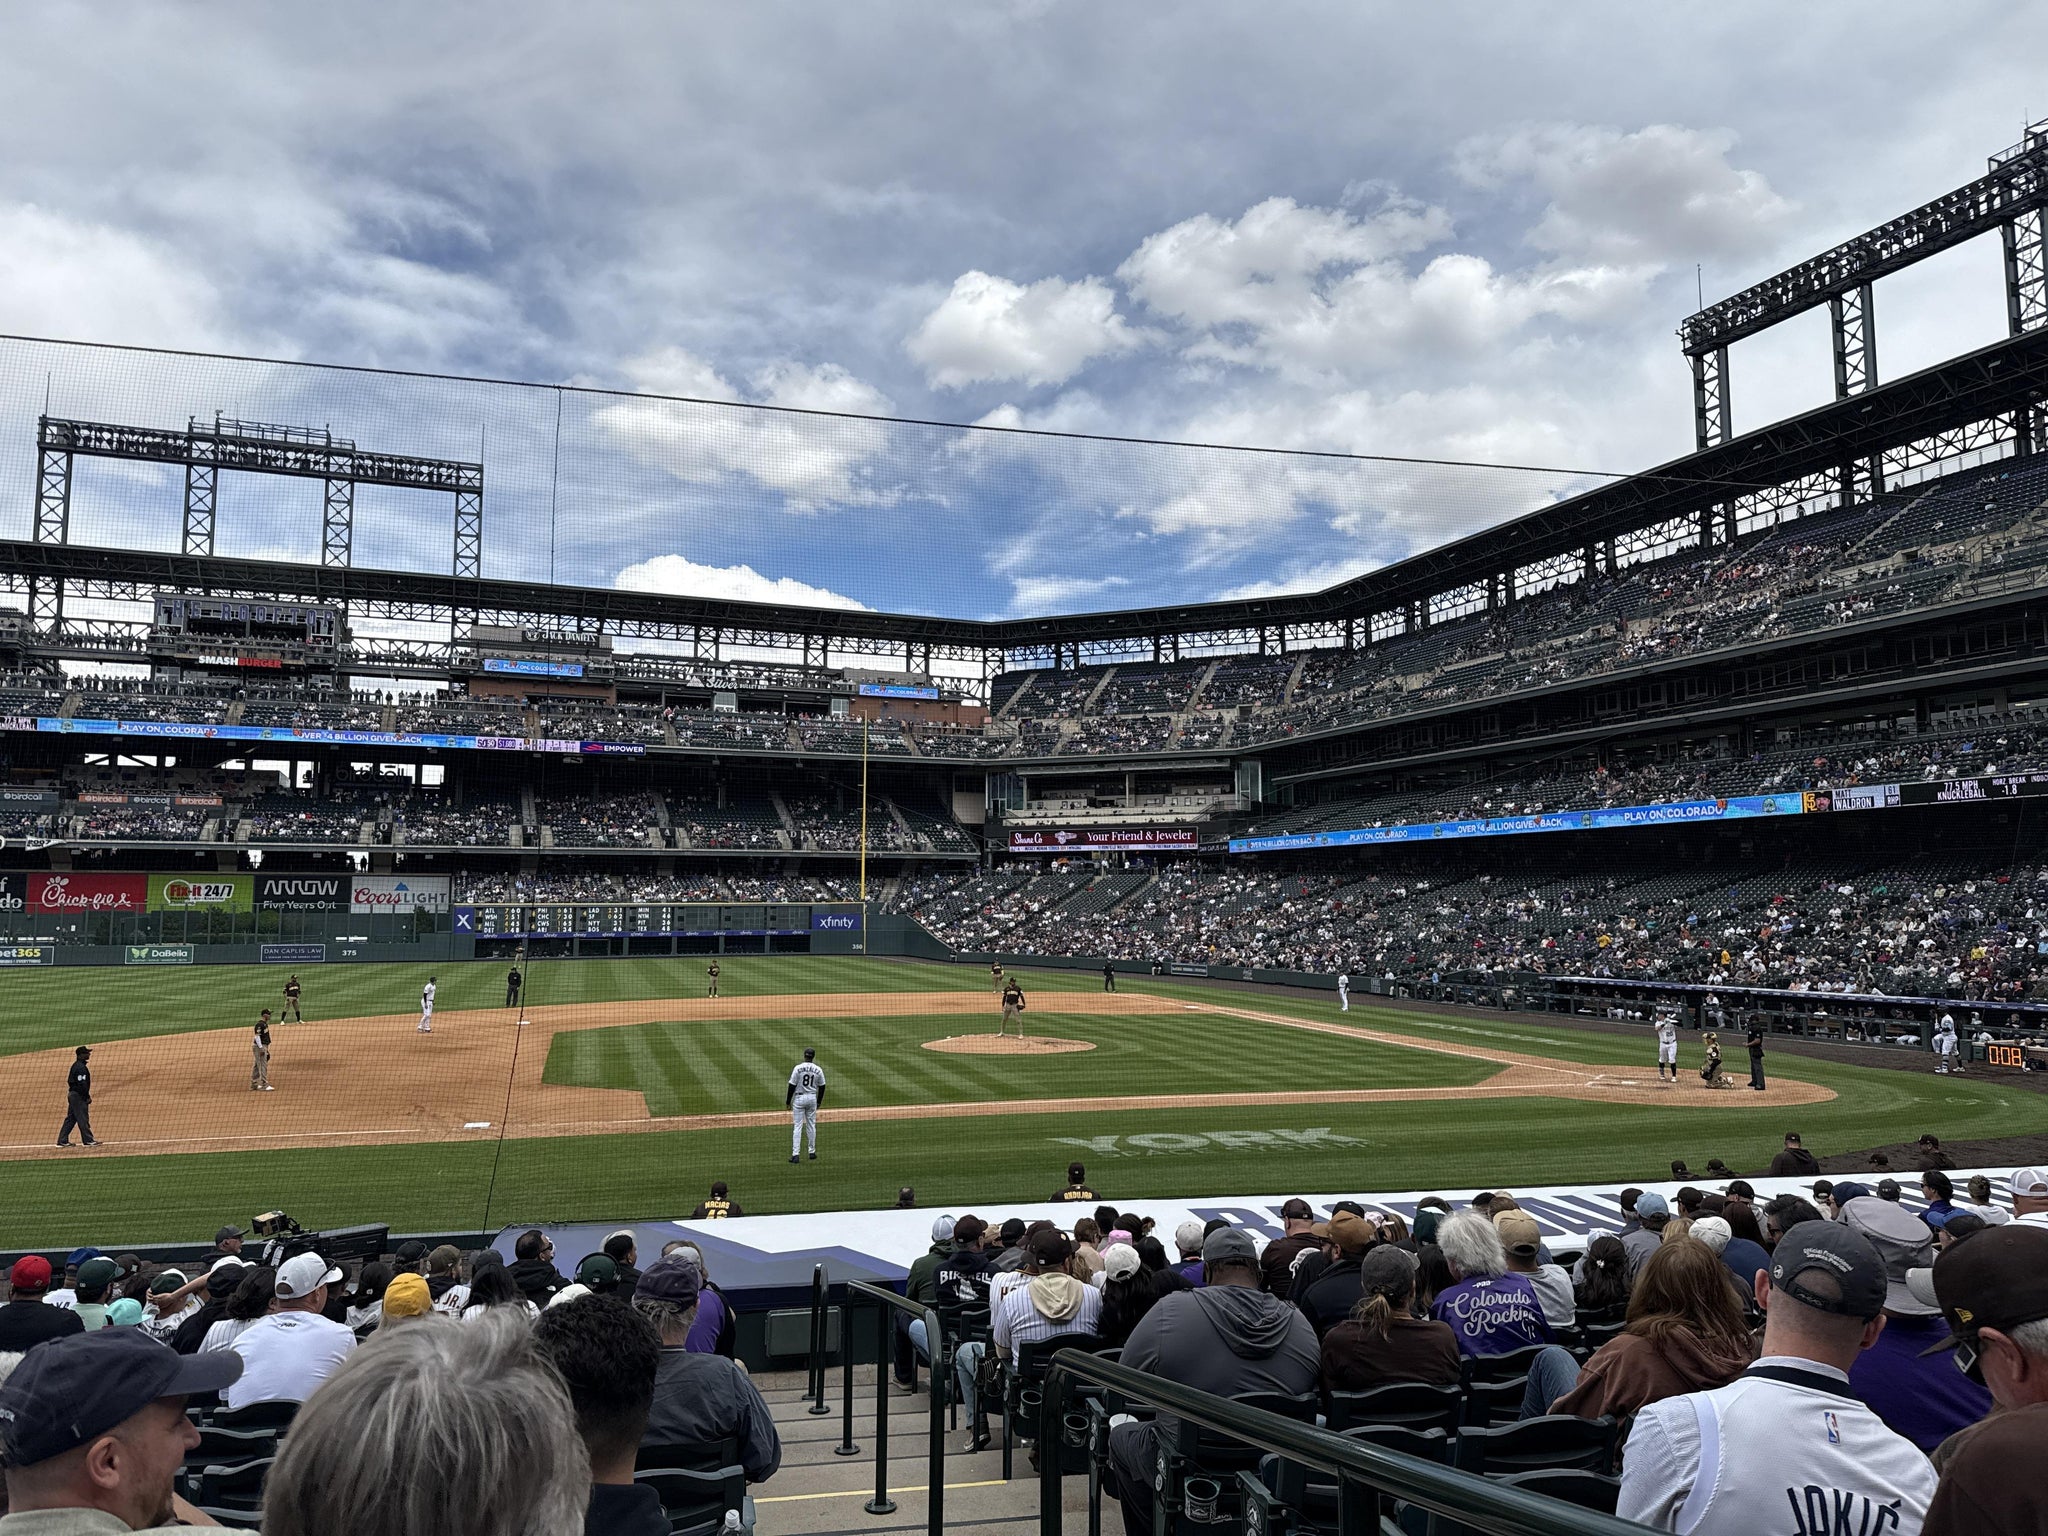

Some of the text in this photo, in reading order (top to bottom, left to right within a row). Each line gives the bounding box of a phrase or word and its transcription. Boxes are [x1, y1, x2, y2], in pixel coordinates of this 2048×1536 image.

[154, 600, 335, 627] THE ROOFTOP
[198, 655, 282, 668] SMASHBURGER
[706, 678, 738, 690] Silver
[120, 724, 144, 732] PLAY
[147, 726, 163, 734] ON,
[299, 731, 321, 740] OVER
[334, 732, 369, 742] BILLION
[370, 734, 397, 743] GIVEN
[1962, 780, 1978, 790] MPH
[2008, 776, 2026, 784] BREAK
[92, 795, 122, 803] birdcall
[1835, 789, 1852, 798] MATT
[1938, 788, 1986, 800] KNUCKLEBALL
[139, 796, 170, 804] birdcall
[187, 798, 216, 806] birdcall
[1834, 797, 1872, 810] WALDRON
[1888, 796, 1898, 805] RHP
[1624, 806, 1723, 821] PLAY ON, COLORADO
[1457, 825, 1476, 833] OVER
[1539, 818, 1562, 827] BACK
[1014, 832, 1043, 844] Shane Co
[1087, 830, 1192, 841] Your Friend & Jeweler
[1350, 833, 1365, 841] PLAY
[1374, 830, 1408, 839] COLORADO
[170, 884, 232, 896] Fix-it 24/7
[264, 880, 338, 896] ARROW
[41, 883, 131, 909] Chick-fil-A
[354, 888, 448, 904] Coors LIGHT
[263, 901, 336, 910] Five Years Out
[820, 916, 854, 928] xfinity
[0, 948, 42, 958] et365
[152, 950, 187, 958] DaBella
[802, 1074, 815, 1087] 81
[1048, 1128, 1369, 1152] YORK
[1064, 1191, 1092, 1200] ANDUJAR
[705, 1201, 730, 1210] MACIAS
[444, 1294, 461, 1308] JR.
[1446, 1289, 1531, 1318] Colorado
